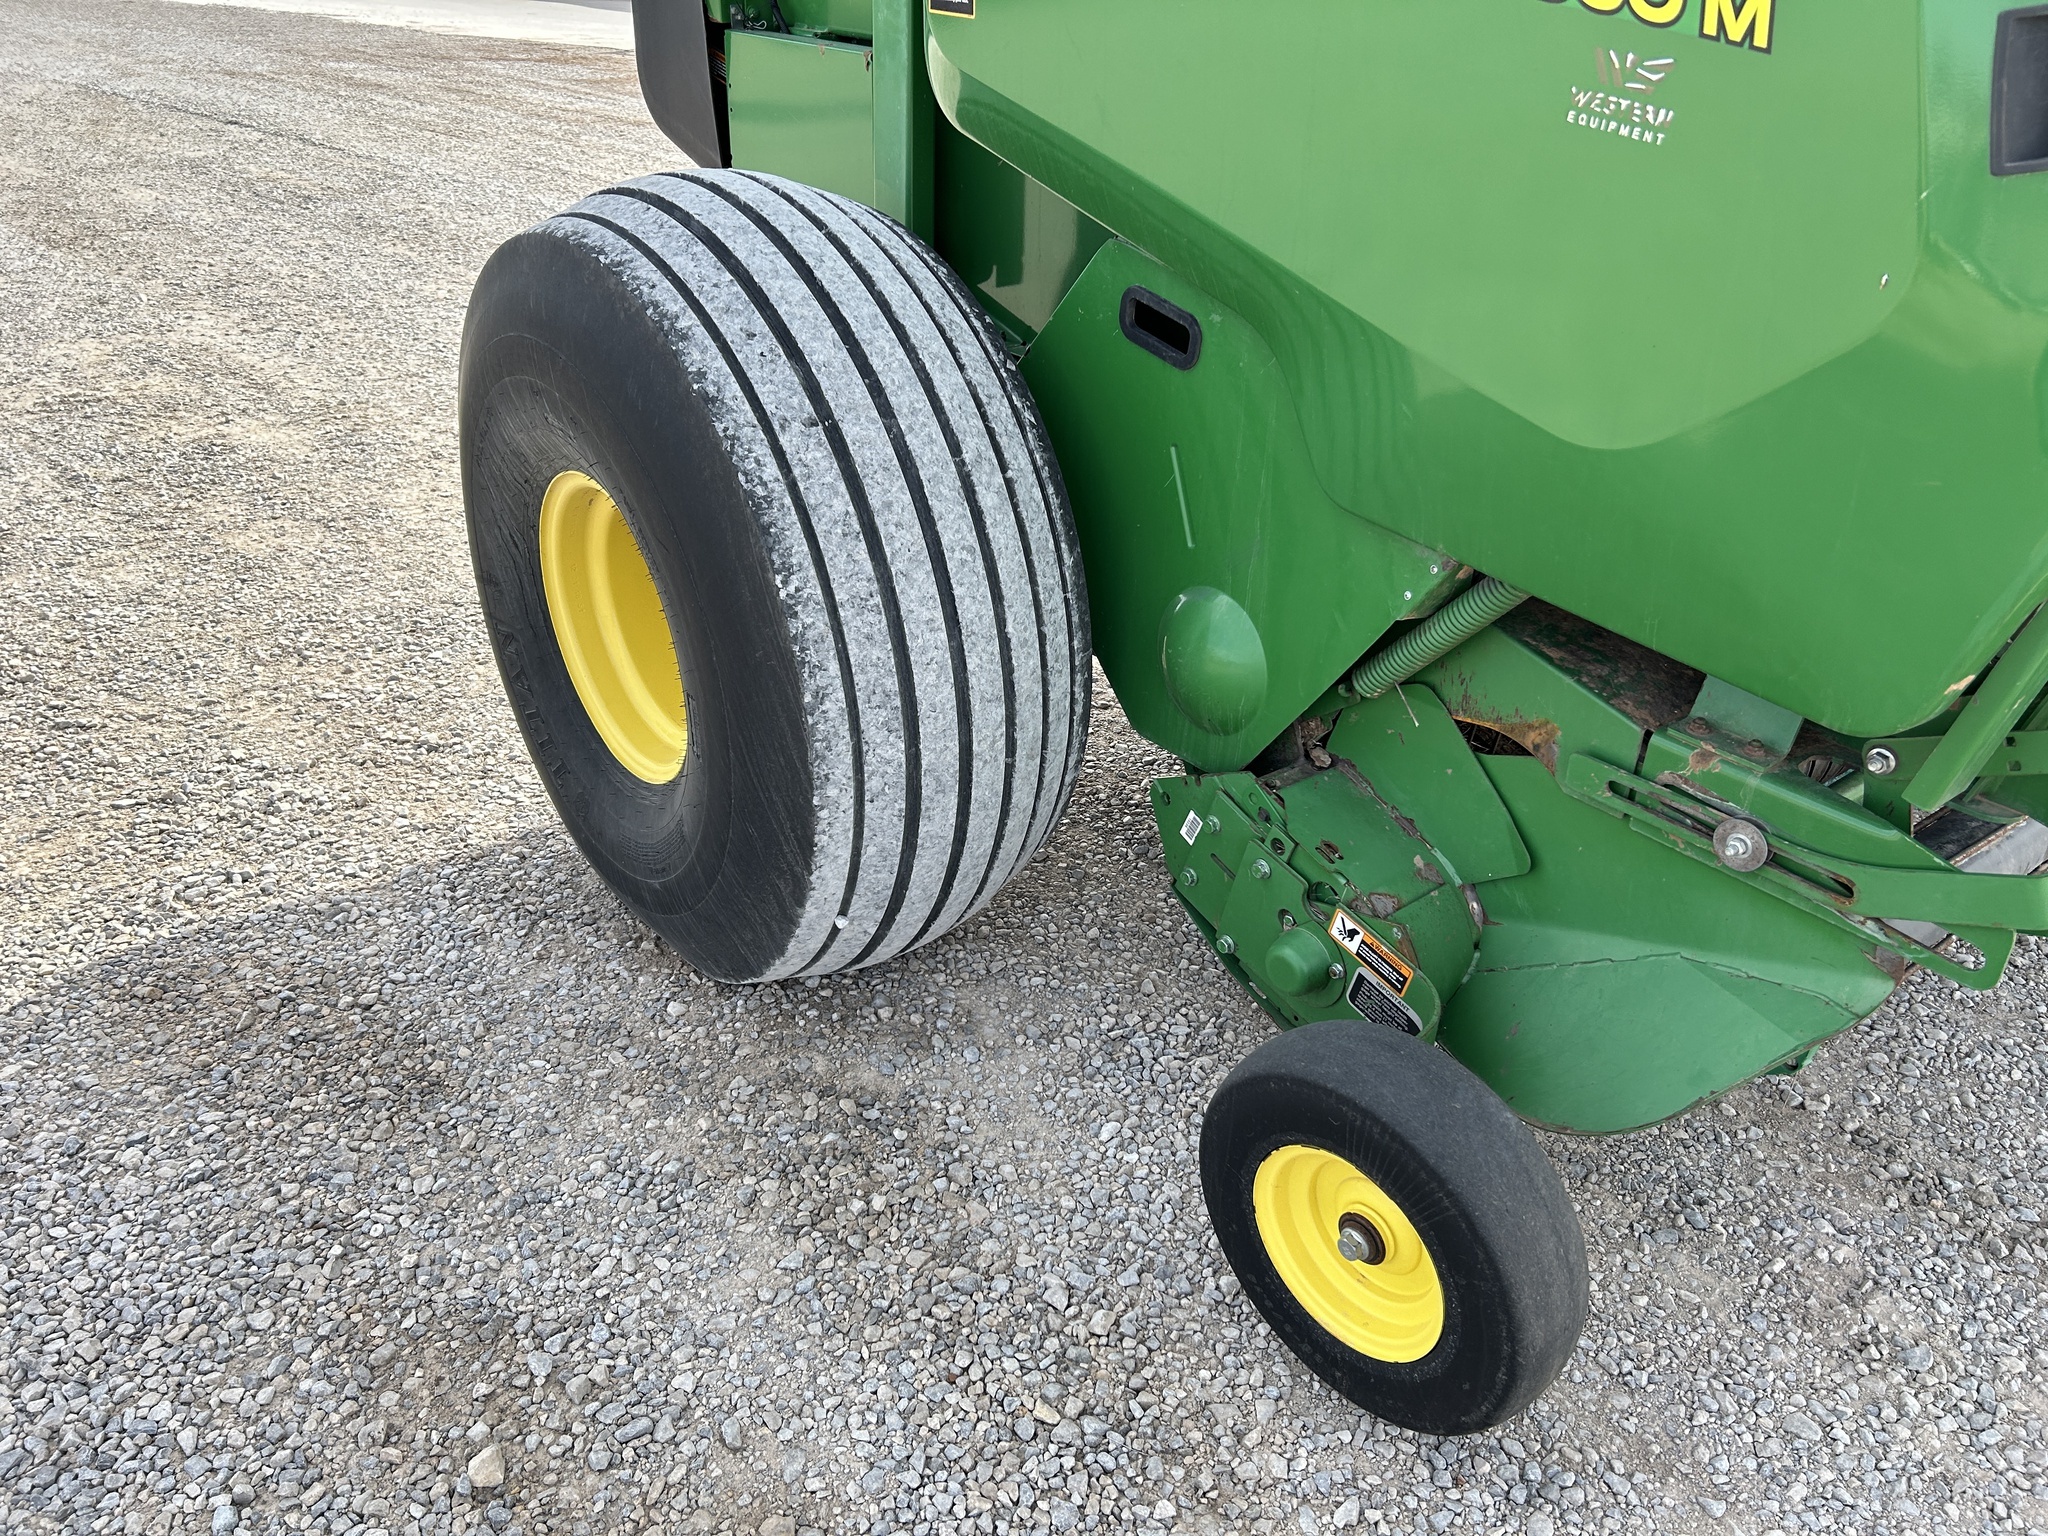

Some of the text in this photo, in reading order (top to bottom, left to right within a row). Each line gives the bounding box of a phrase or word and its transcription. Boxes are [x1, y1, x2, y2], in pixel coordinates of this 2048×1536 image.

[1571, 85, 1674, 127] WESTERN
[1566, 110, 1666, 146] EQUIPMENT
[494, 621, 571, 790] TITAN
[1374, 943, 1402, 971] WARNING
[1375, 980, 1411, 1012] IMPORTANT
